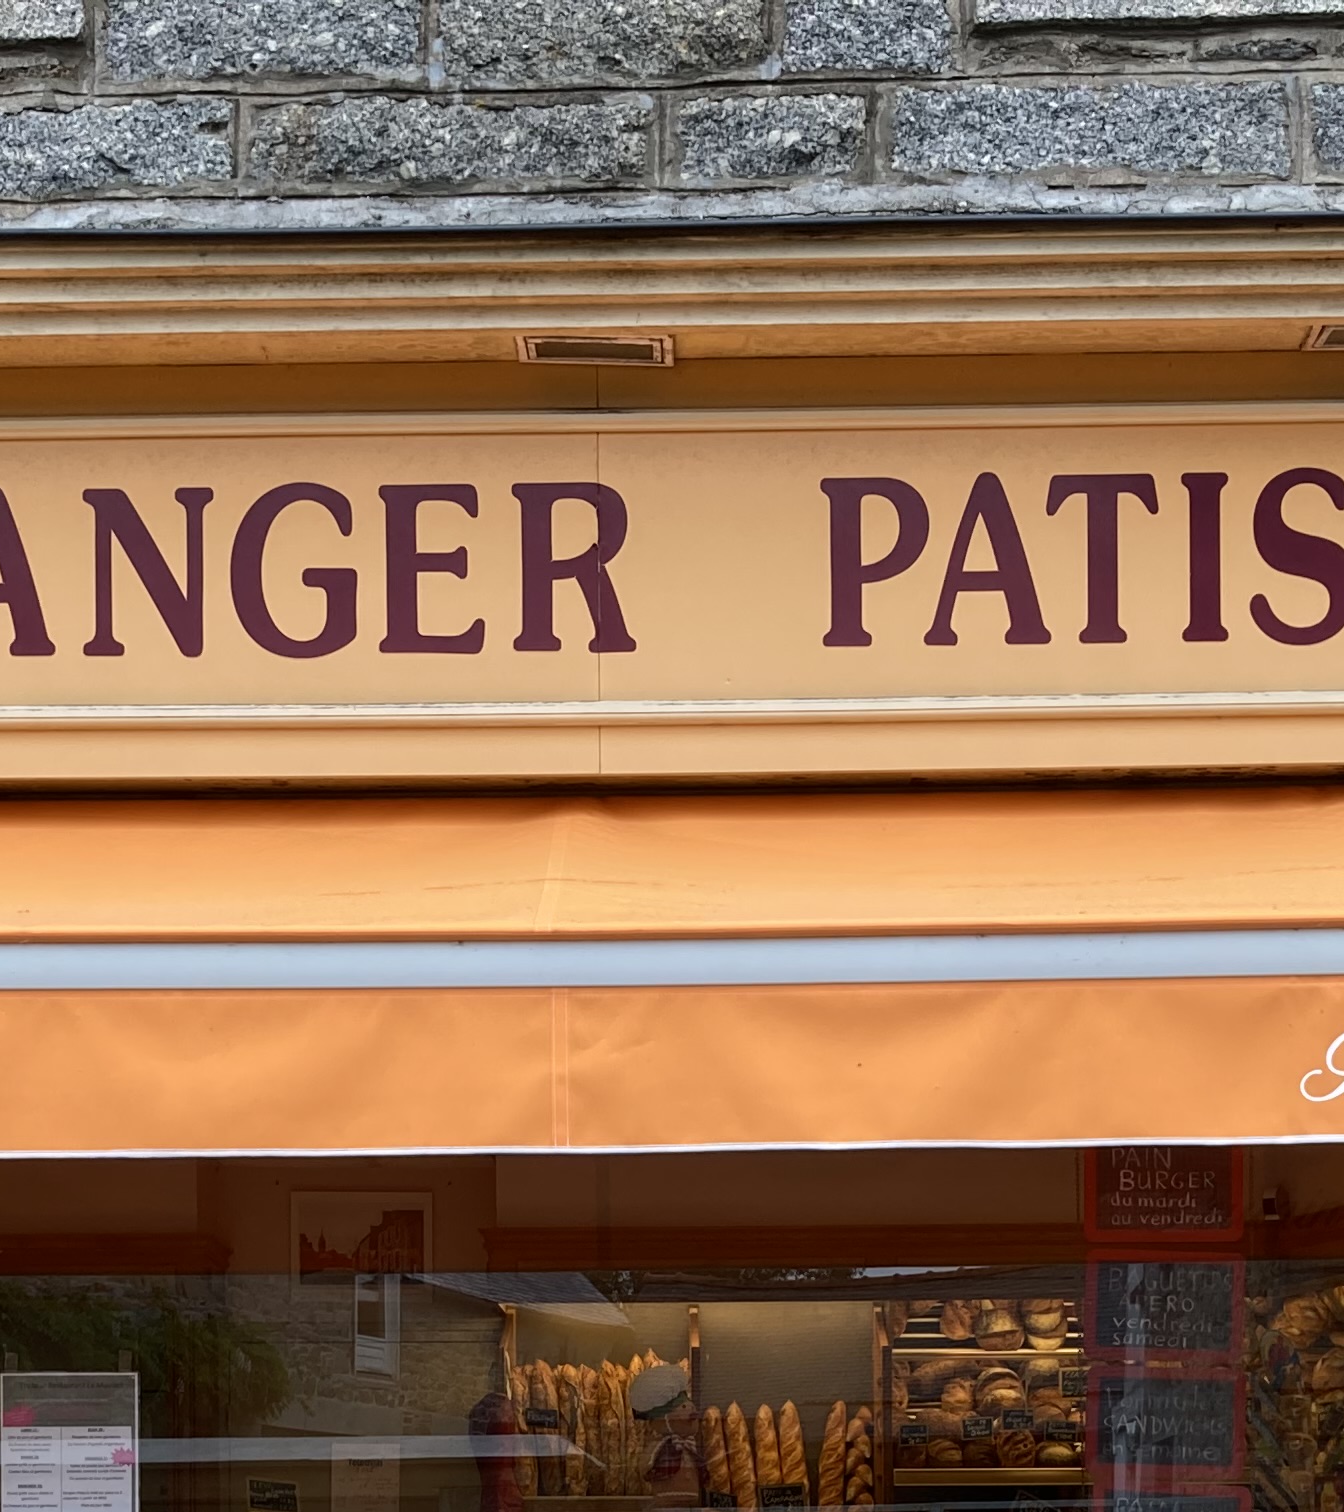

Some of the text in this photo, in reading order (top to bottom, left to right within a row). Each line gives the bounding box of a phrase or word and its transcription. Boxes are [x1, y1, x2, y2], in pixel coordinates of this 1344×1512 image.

[1110, 1147, 1172, 1170] PAIN
[1118, 1169, 1217, 1192] BURGER
[1110, 1191, 1197, 1209] du mardi
[1140, 1207, 1223, 1227] vendredi
[1112, 1313, 1213, 1333] vendredi
[1112, 1332, 1188, 1350] samedi
